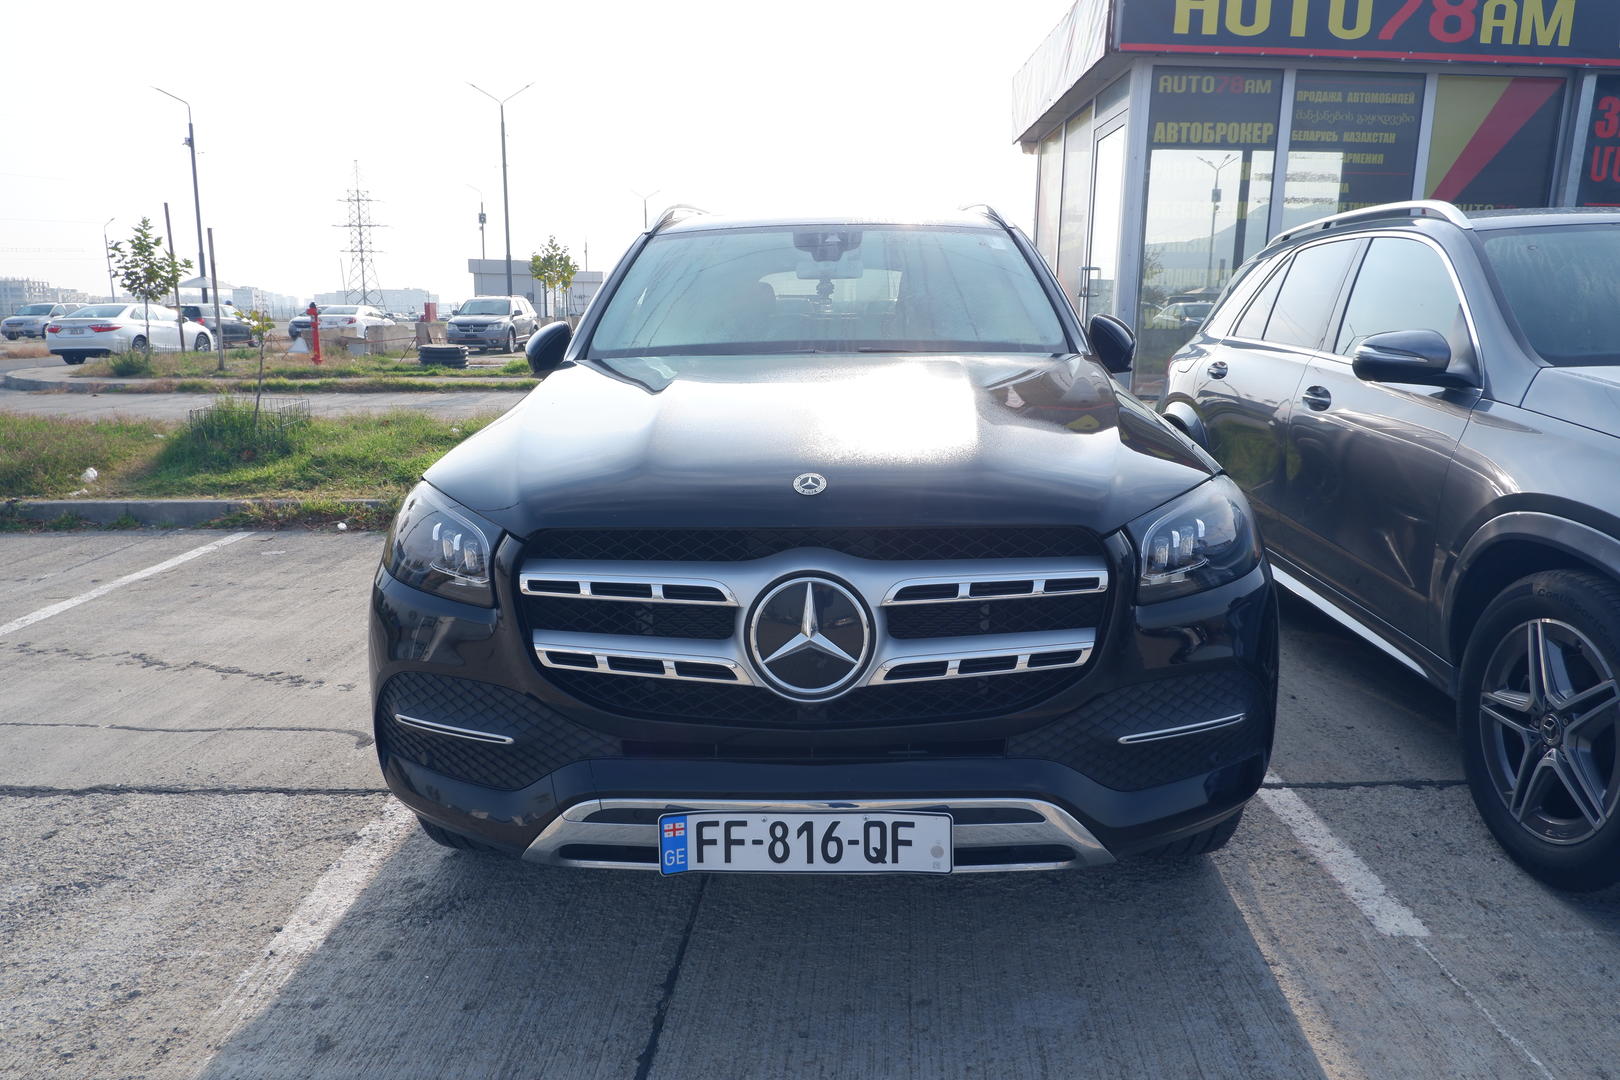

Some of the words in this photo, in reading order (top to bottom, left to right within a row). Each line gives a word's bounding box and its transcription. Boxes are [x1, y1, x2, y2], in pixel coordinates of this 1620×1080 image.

[1172, 0, 1576, 47] AUTO78AM
[1158, 75, 1272, 94] AUTO78AM
[1296, 91, 1342, 103] ПРОДАЖА
[1347, 92, 1415, 104] АВТОМОБИЛЕЙ
[1153, 122, 1273, 143] АВТОБРОКЕР
[1292, 130, 1338, 142] БЕЛАРУСЬ
[1343, 132, 1396, 144] КАЗАХСТАН
[696, 821, 915, 864] FF-816-QF
[664, 848, 686, 865] GE
